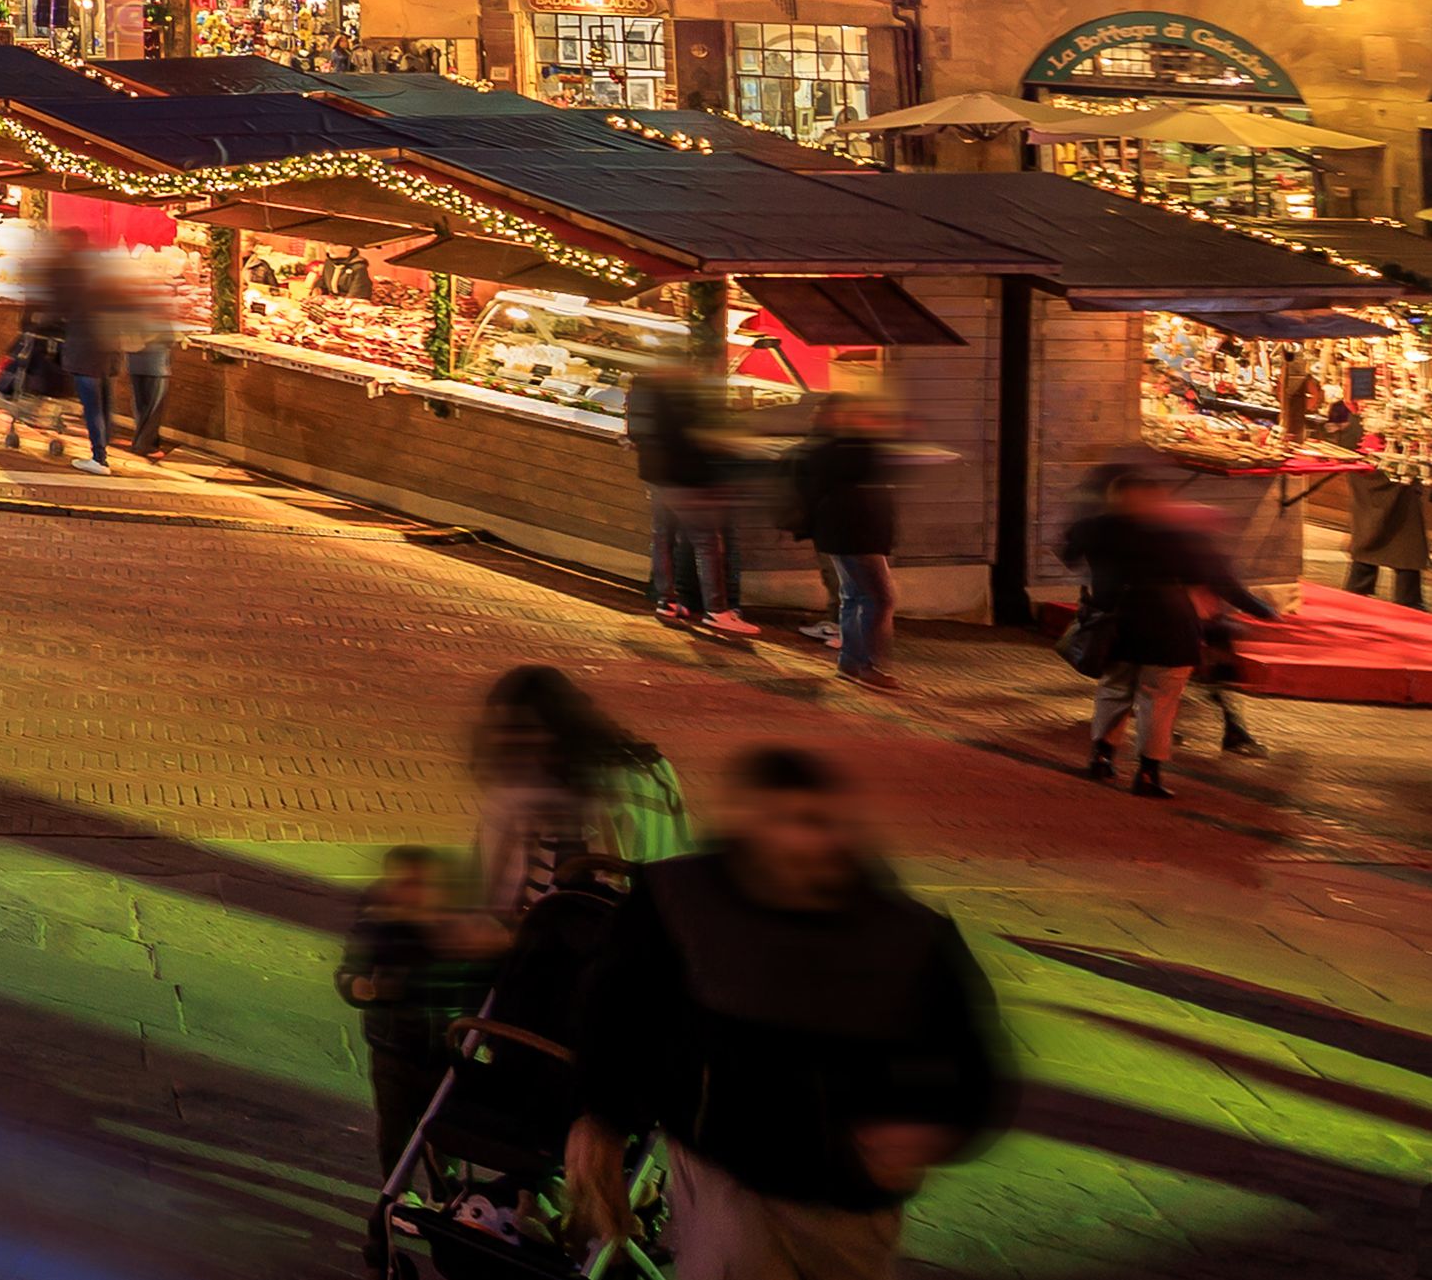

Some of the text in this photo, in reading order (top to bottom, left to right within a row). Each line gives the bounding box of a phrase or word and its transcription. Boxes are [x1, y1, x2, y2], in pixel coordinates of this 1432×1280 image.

[1047, 49, 1077, 70] La
[1073, 25, 1157, 52] Bottega
[1162, 22, 1185, 39] di
